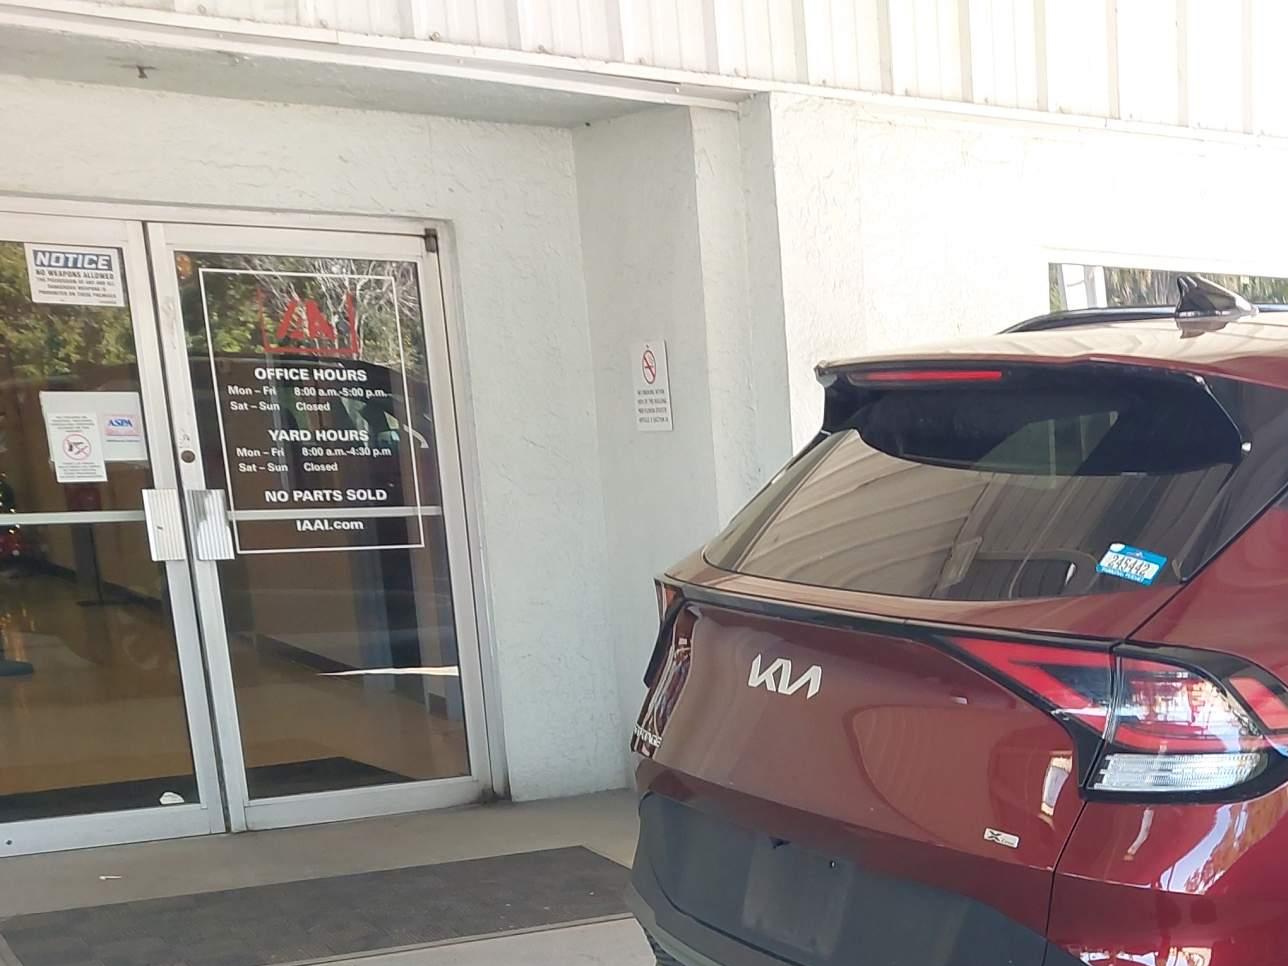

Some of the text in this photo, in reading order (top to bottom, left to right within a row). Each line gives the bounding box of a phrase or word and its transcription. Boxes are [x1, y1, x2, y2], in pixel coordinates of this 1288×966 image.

[36, 251, 110, 270] NOTICE
[254, 367, 368, 382] OFFICE HOURS
[227, 384, 253, 396] Mon
[262, 385, 278, 396] Fri
[294, 386, 316, 397] 8:00
[230, 400, 249, 411] Sat
[259, 401, 281, 411] Sun
[296, 402, 331, 412] Closed
[108, 418, 133, 428] ASPA
[268, 429, 370, 442] YARD HOURS
[236, 447, 261, 457] Mon
[271, 447, 285, 457] Fri
[302, 446, 324, 457] 8:00
[238, 462, 257, 473] Sat
[267, 462, 289, 472] Sun
[303, 461, 339, 472] Closed
[264, 489, 388, 502] NO PARTS SOLD
[296, 519, 365, 532] IAAI.com
[747, 653, 823, 700] KIA
